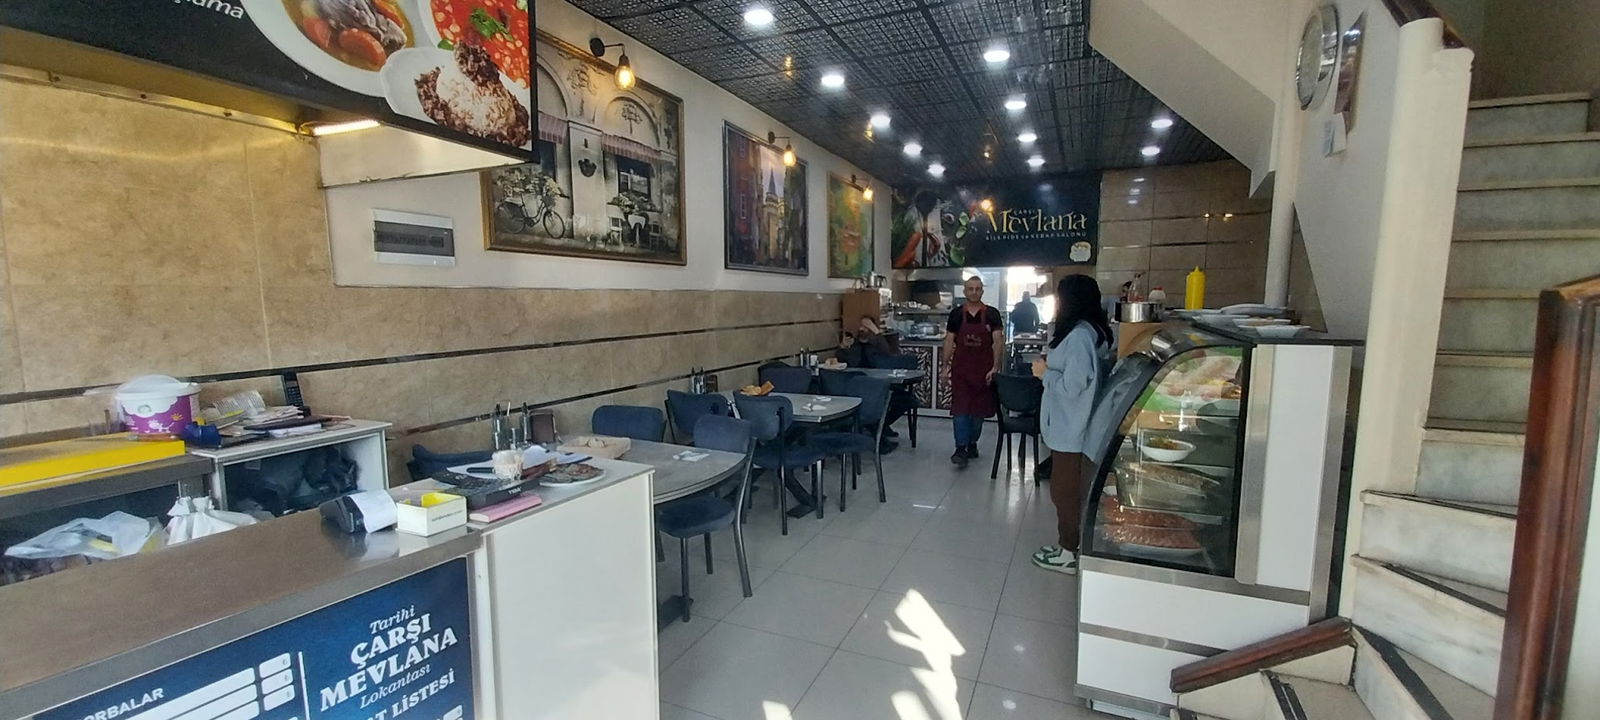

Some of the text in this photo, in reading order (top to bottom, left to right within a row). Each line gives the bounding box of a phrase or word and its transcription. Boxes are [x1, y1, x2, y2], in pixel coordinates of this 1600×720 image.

[351, 613, 431, 669] ÇARŞI
[370, 605, 415, 634] Tarihi
[320, 627, 458, 712] MEVLANA
[360, 664, 431, 709] Lokantası
[391, 668, 455, 718] LİSTESİ
